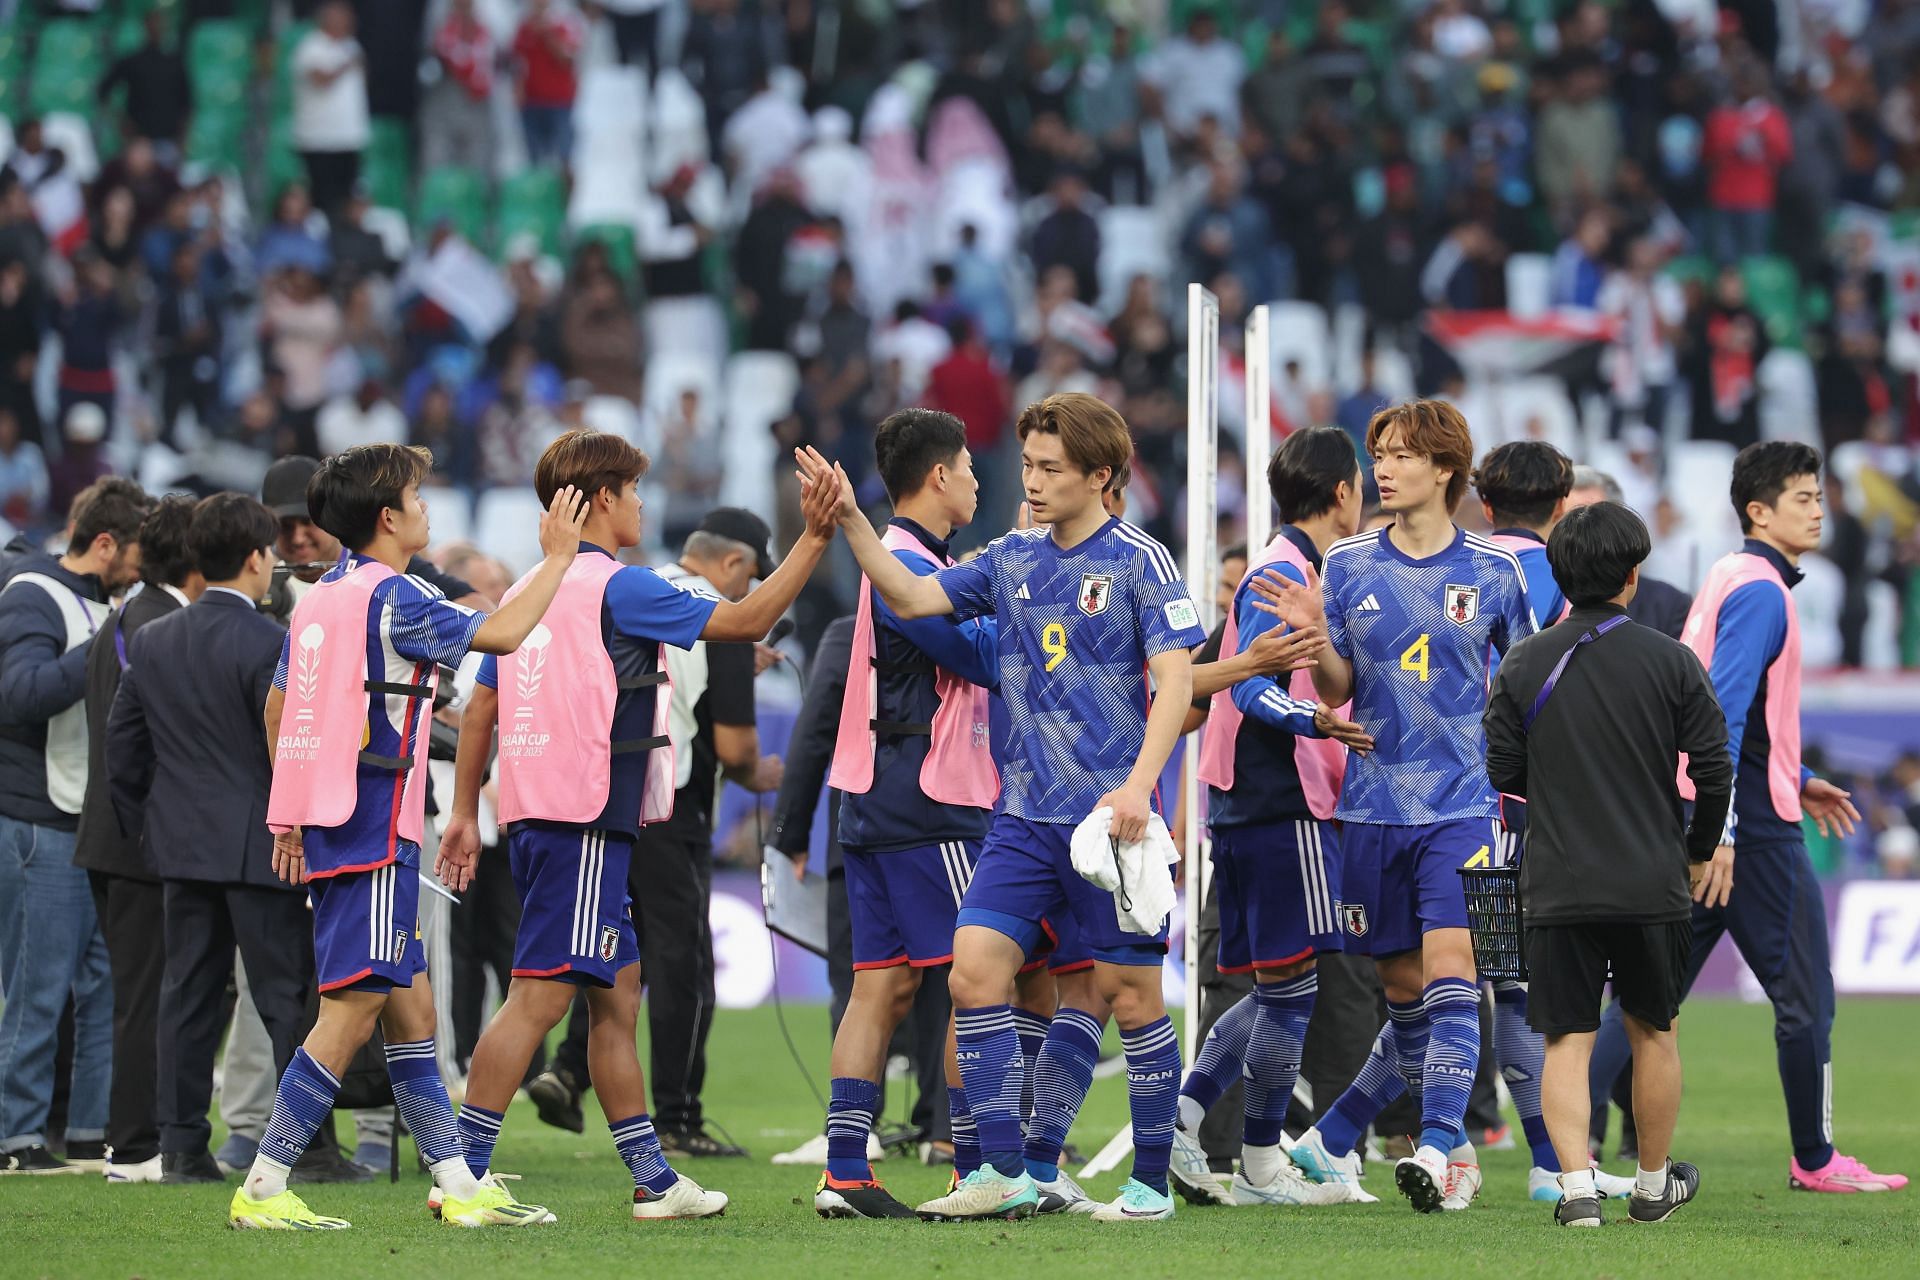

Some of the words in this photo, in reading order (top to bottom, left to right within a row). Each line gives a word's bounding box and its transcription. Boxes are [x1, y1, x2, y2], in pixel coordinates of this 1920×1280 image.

[1042, 623, 1067, 672] 9
[1400, 633, 1429, 682] 4
[296, 725, 312, 735] AFC
[513, 723, 531, 732] AFC
[278, 736, 309, 749] ASIAN
[528, 734, 550, 746] CUP
[277, 750, 305, 761] QATAR
